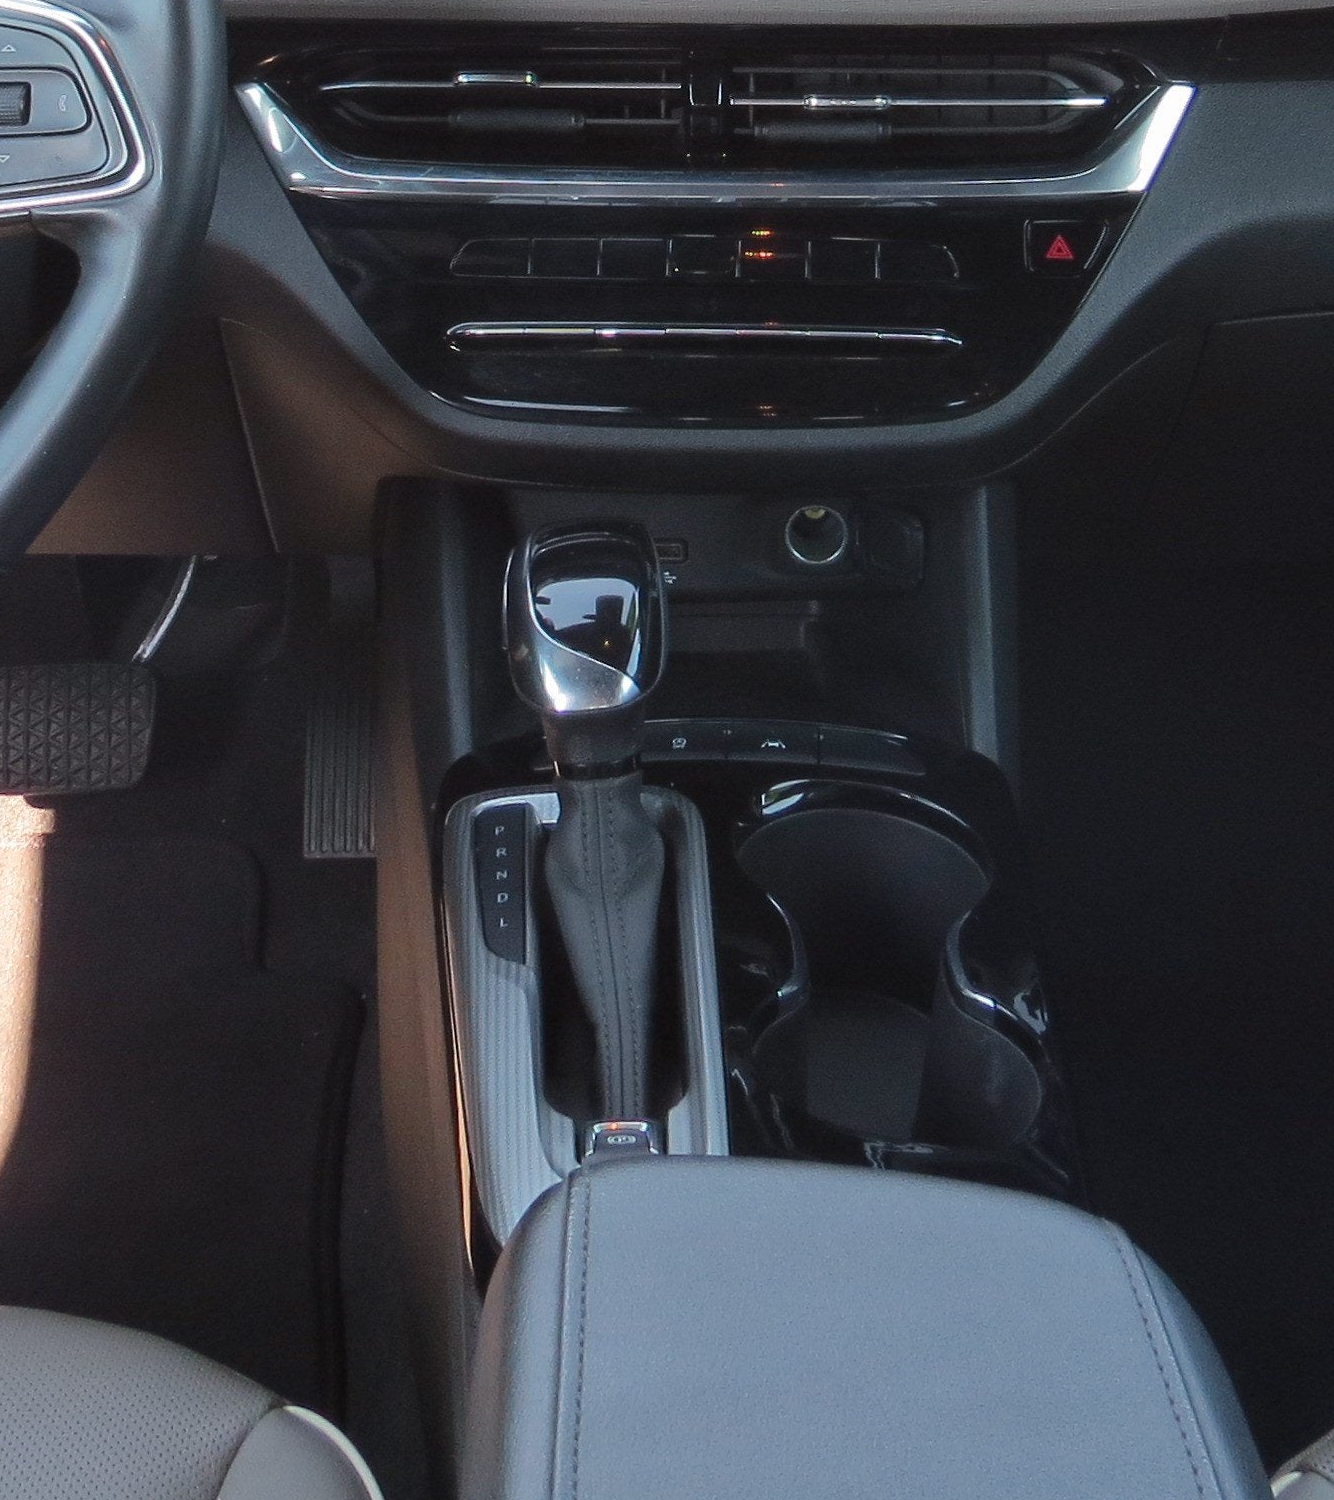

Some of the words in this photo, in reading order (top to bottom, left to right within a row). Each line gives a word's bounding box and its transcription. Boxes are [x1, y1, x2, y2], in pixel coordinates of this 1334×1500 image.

[494, 825, 505, 836] P
[496, 847, 507, 858] R
[496, 870, 507, 881] N
[497, 892, 508, 903] D
[499, 917, 508, 929] L
